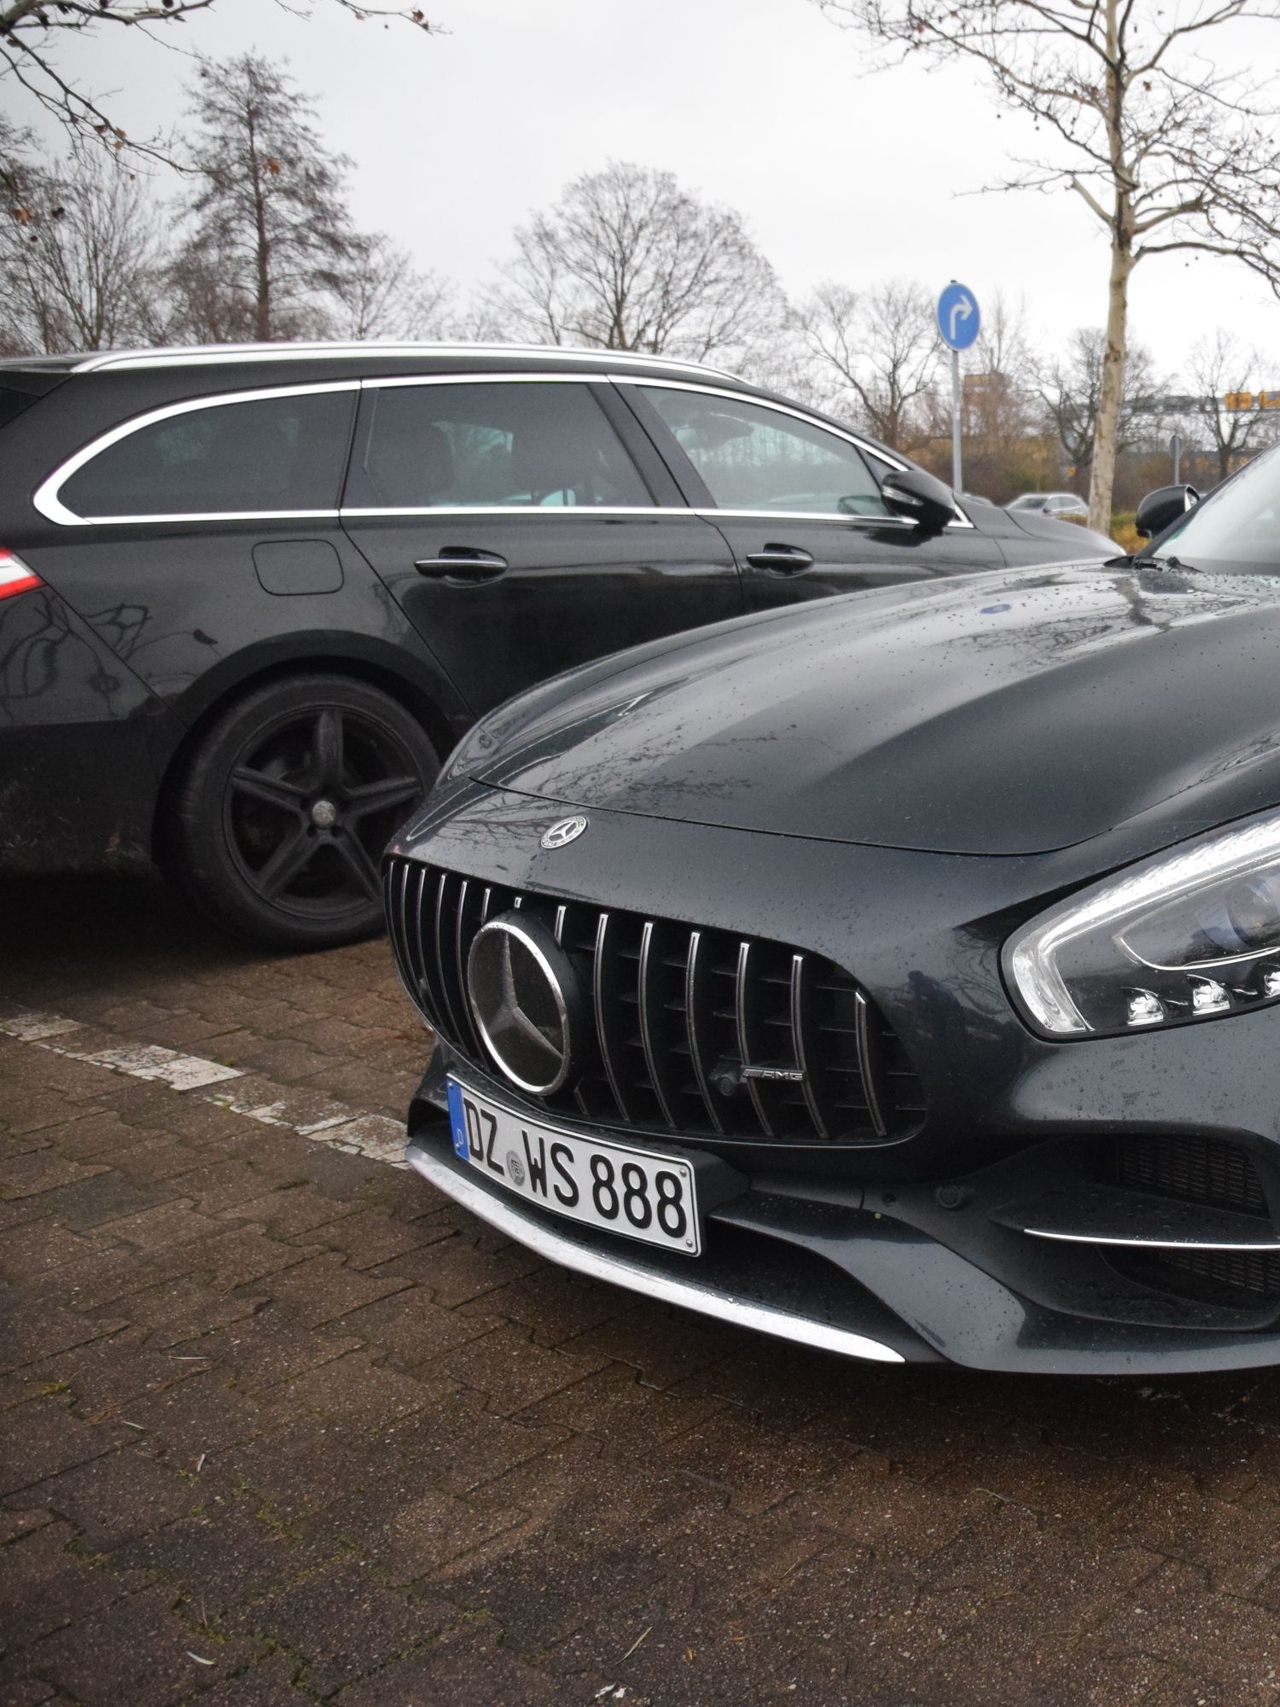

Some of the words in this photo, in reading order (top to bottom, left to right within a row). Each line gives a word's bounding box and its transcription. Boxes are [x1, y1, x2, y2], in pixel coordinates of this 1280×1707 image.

[761, 1070, 803, 1081] AMG
[457, 1127, 464, 1145] D
[463, 1097, 504, 1176] DZ
[522, 1129, 580, 1208] WS
[590, 1153, 688, 1239] 888
